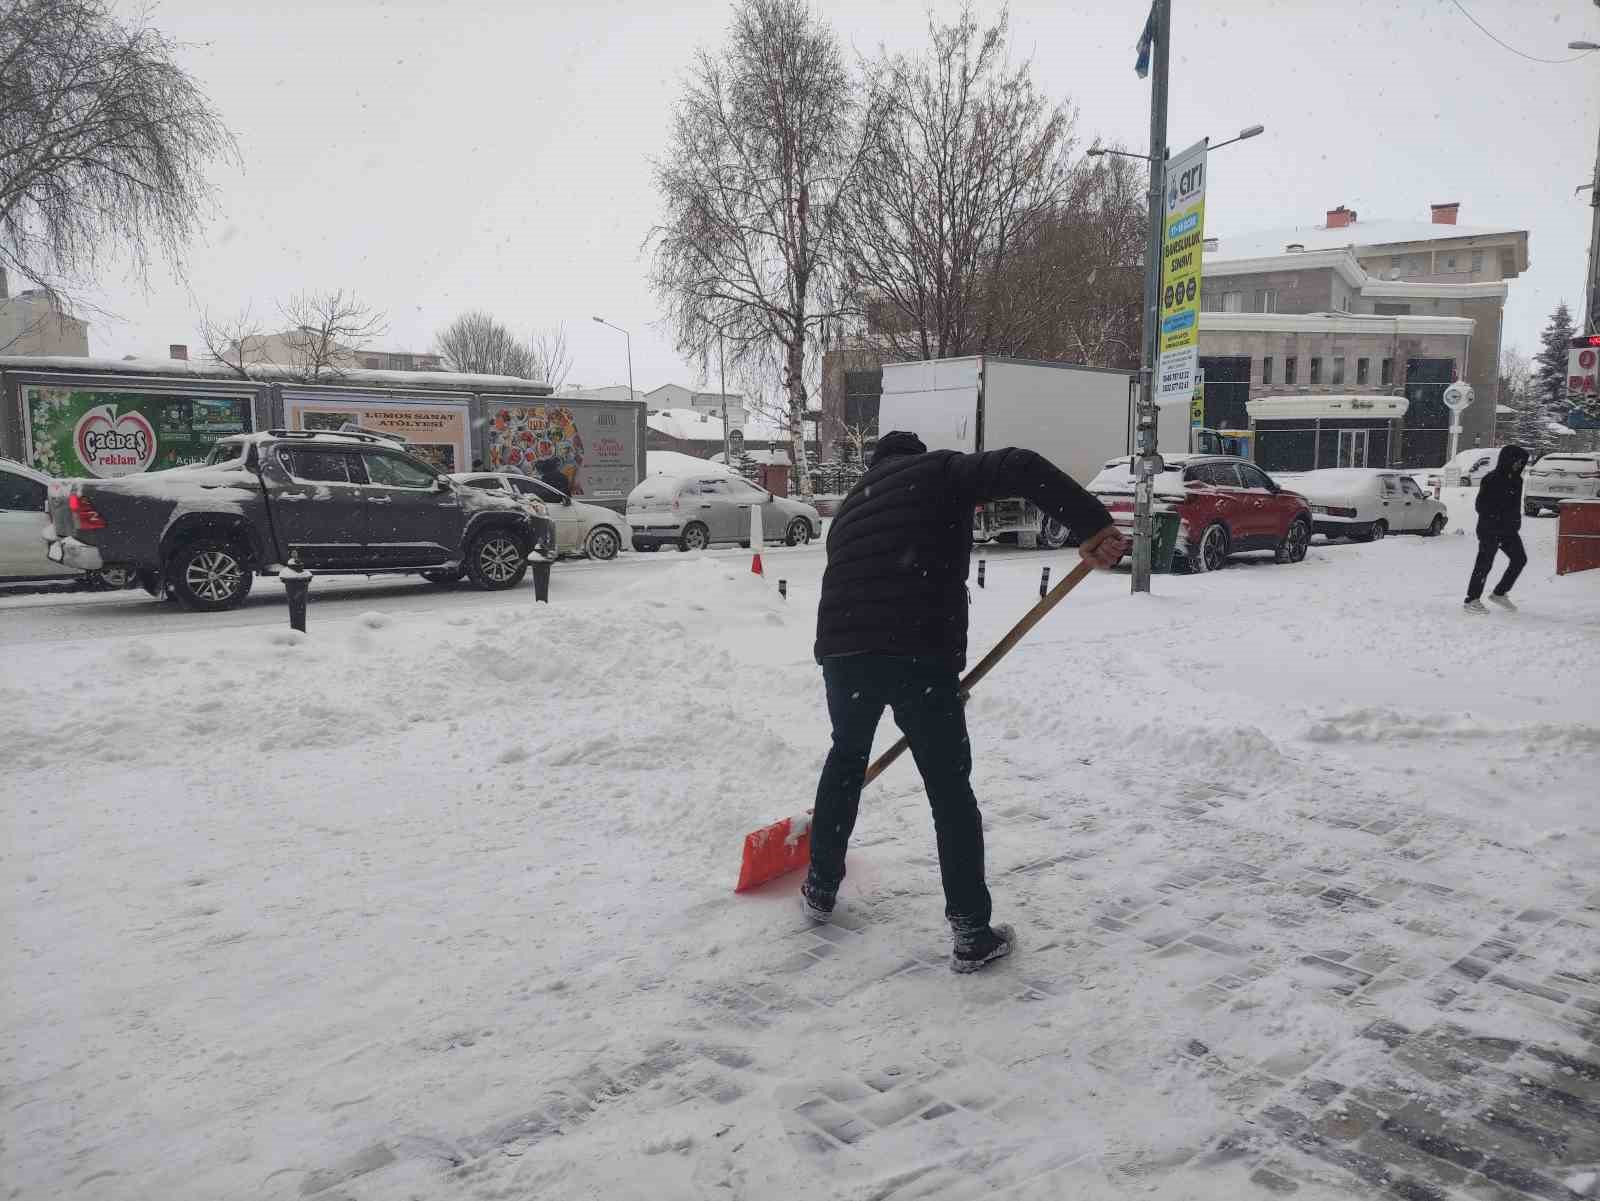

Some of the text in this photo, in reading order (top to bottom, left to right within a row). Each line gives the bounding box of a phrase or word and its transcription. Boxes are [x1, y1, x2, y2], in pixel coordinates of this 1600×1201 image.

[1165, 232, 1201, 257] BURSLULUK
[414, 413, 456, 421] SANAT
[99, 455, 137, 466] reklam
